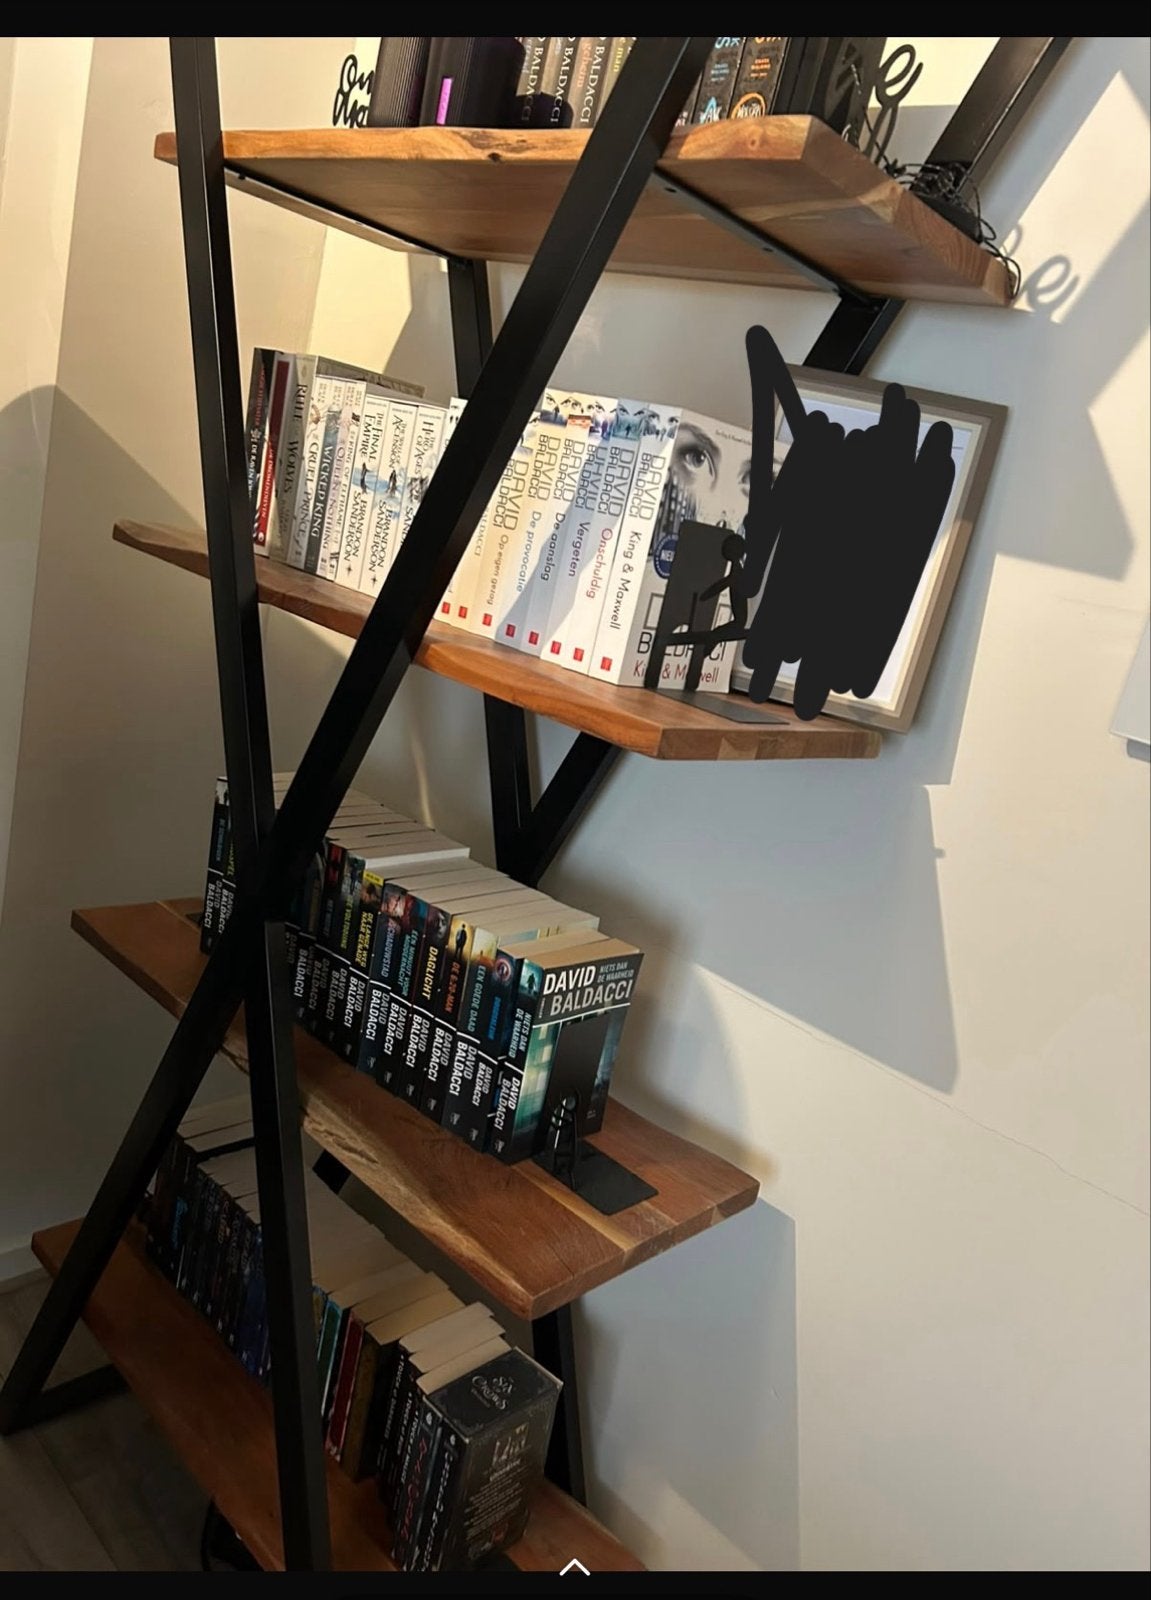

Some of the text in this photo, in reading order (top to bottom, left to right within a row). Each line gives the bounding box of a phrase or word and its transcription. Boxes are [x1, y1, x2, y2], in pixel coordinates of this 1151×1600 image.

[521, 47, 544, 121] BALDACCI
[550, 47, 573, 122] BALDACCI
[580, 46, 605, 123] BALDACCI
[360, 414, 376, 458] EMPIRE
[368, 427, 383, 463] FINAL
[389, 414, 403, 469] ASCENSION
[414, 447, 425, 475] AGES
[422, 421, 434, 452] HERO
[283, 441, 299, 493] WOLVES
[304, 442, 319, 486] CRUEL
[528, 434, 548, 499] BALDACCI
[537, 436, 561, 501] DAVID
[553, 438, 574, 500] BALDACCI
[561, 440, 586, 502] DAVID
[575, 444, 597, 509] BALDACCI
[597, 446, 620, 514] BALDACCI
[607, 448, 635, 517] DAVID
[629, 452, 653, 518] BALDACCI
[639, 455, 666, 521] DAVID
[311, 446, 333, 537] WICKED KING
[503, 460, 530, 531] DAVID
[322, 498, 337, 549] NOTHING
[344, 490, 361, 562] SANDERSON
[353, 499, 367, 557] BRANDON
[369, 499, 387, 572] SANDERSON
[377, 507, 393, 568] BRANDON
[498, 534, 509, 550] Op
[540, 511, 566, 581] De aanslag
[568, 521, 591, 577] Vergeten
[516, 510, 542, 592] De provocatie
[586, 528, 613, 599] Onschuldig
[609, 530, 642, 630] King & Maxwell
[662, 663, 671, 679] &
[204, 883, 215, 928] BALDACCI
[293, 948, 308, 997] BALDACCI
[308, 960, 322, 1010] BALDACCI
[337, 967, 348, 1000] DAVID
[422, 945, 439, 1000] DAGLICHT
[543, 965, 597, 995] DAVID
[600, 961, 628, 973] NIETS DAN
[605, 969, 635, 981] WAARHEID
[326, 970, 340, 1021] BALDACCI
[344, 976, 359, 1028] BALDACCI
[354, 980, 366, 1012] DAVID
[365, 989, 382, 1041] BALDACCI
[378, 992, 390, 1025] DAVID
[467, 965, 486, 1032] EEN GOEDE DAAD
[550, 979, 634, 1016] BALDACCI
[383, 1002, 400, 1056] BALDACCI
[395, 1007, 408, 1041] DAVID
[405, 1014, 422, 1068] BALDACCI
[417, 1019, 431, 1053] DAVID
[439, 1032, 453, 1067] DAVID
[508, 1008, 525, 1059] DE WAARHEID
[518, 1012, 532, 1052] NIETS DAN
[427, 1027, 445, 1082] BALDACCI
[449, 1041, 468, 1096] BALDACCI
[463, 1045, 478, 1080] DAVID
[481, 1066, 493, 1095] DAVID
[471, 1062, 487, 1107] BALDACCI
[494, 1078, 512, 1131] BALDACCI
[507, 1076, 521, 1111] DAVID
[410, 1415, 418, 1444] TOUCH
